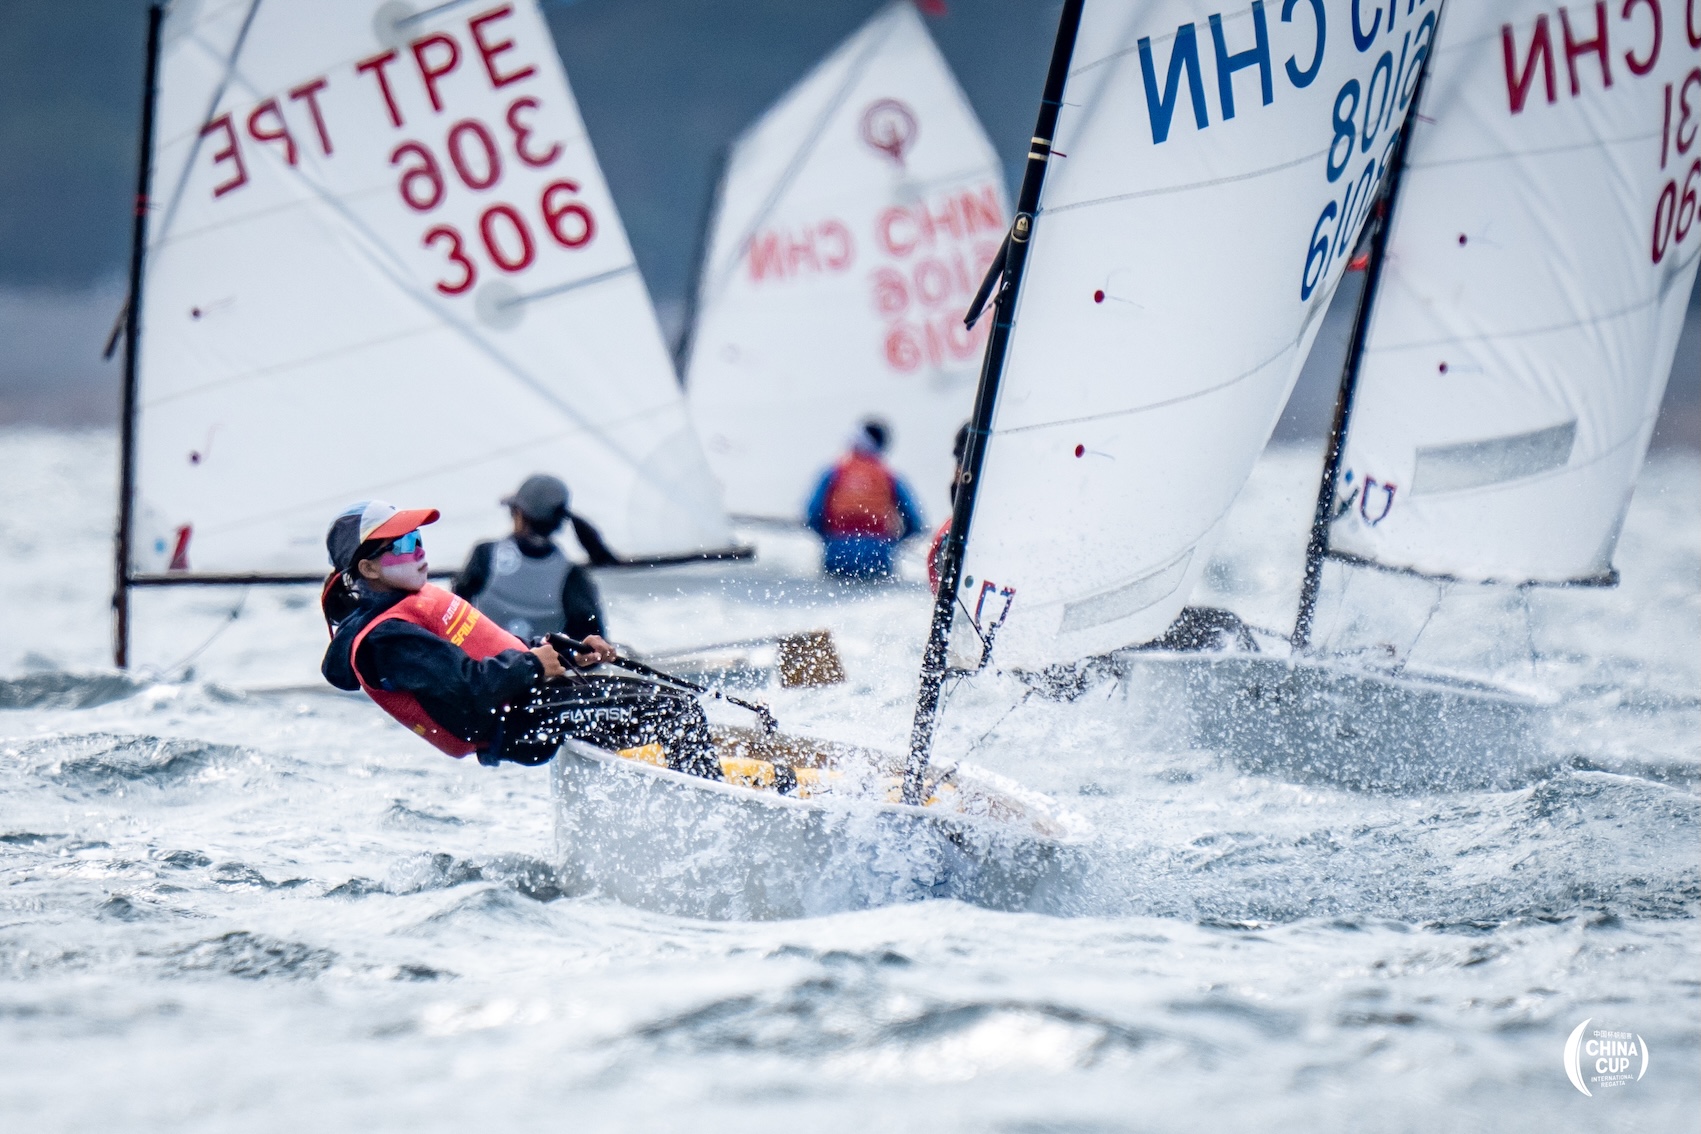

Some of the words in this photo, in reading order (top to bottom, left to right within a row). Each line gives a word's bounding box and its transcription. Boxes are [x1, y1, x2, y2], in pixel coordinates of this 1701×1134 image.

[356, 5, 537, 127] TPE
[423, 180, 597, 295] 306
[876, 187, 1003, 257] CHN
[1652, 157, 1701, 265] 06
